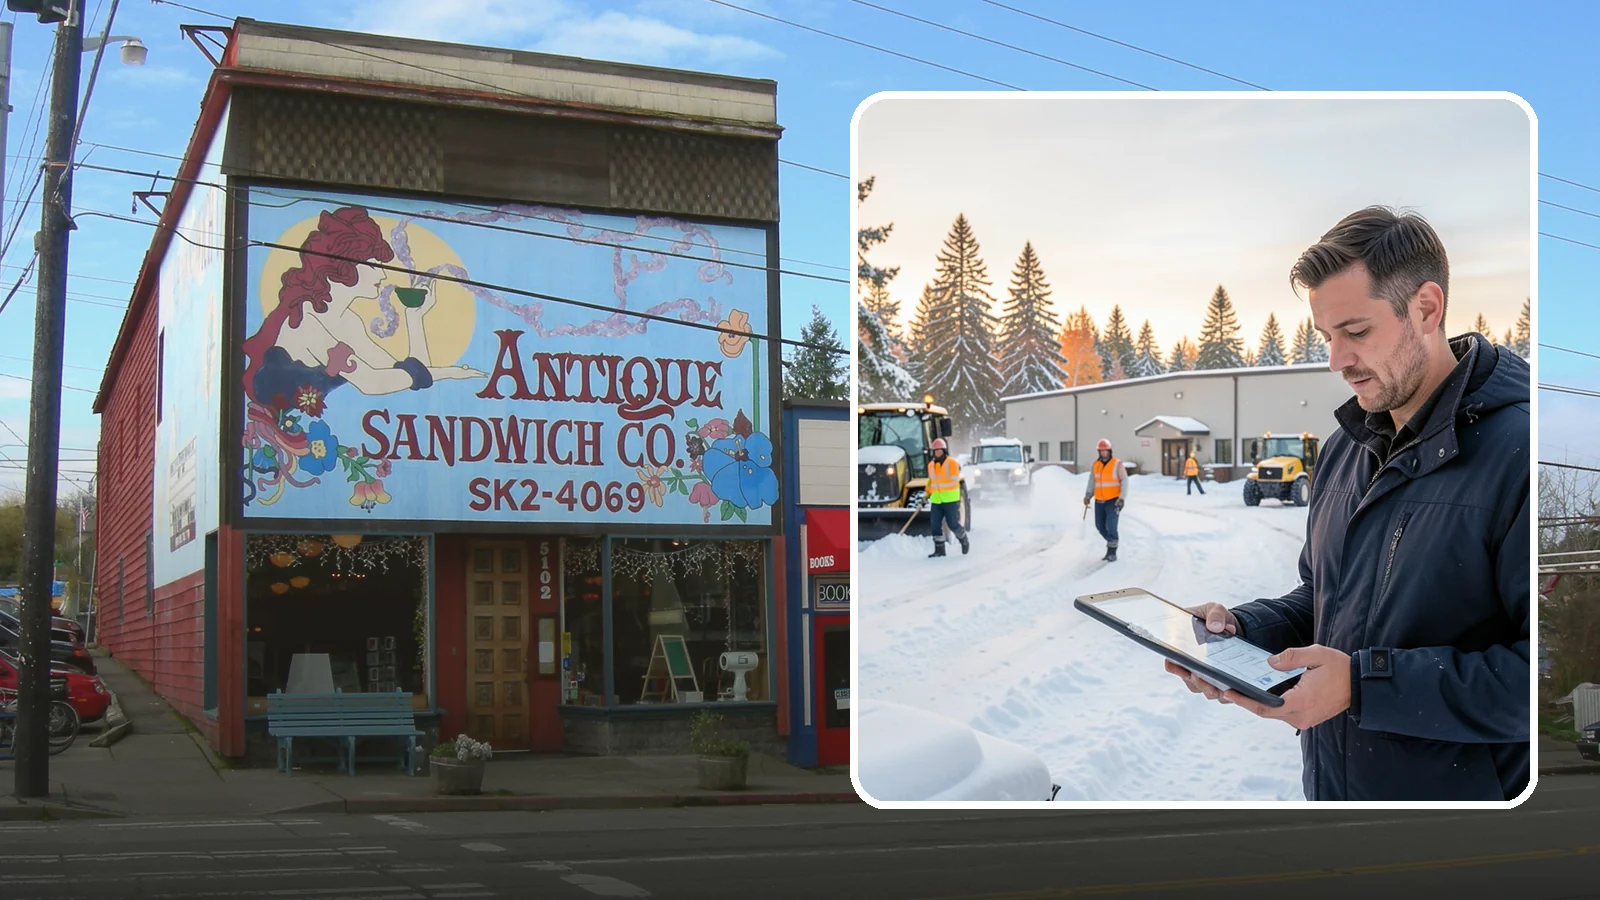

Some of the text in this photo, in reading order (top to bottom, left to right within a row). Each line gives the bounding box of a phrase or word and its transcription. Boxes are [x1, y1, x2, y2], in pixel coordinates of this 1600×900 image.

[476, 329, 723, 420] ANTIQUE
[361, 409, 685, 469] SANDWICH CO.
[468, 477, 645, 513] SK2-4069
[540, 542, 551, 599] 5102
[809, 555, 835, 569] BOOKS
